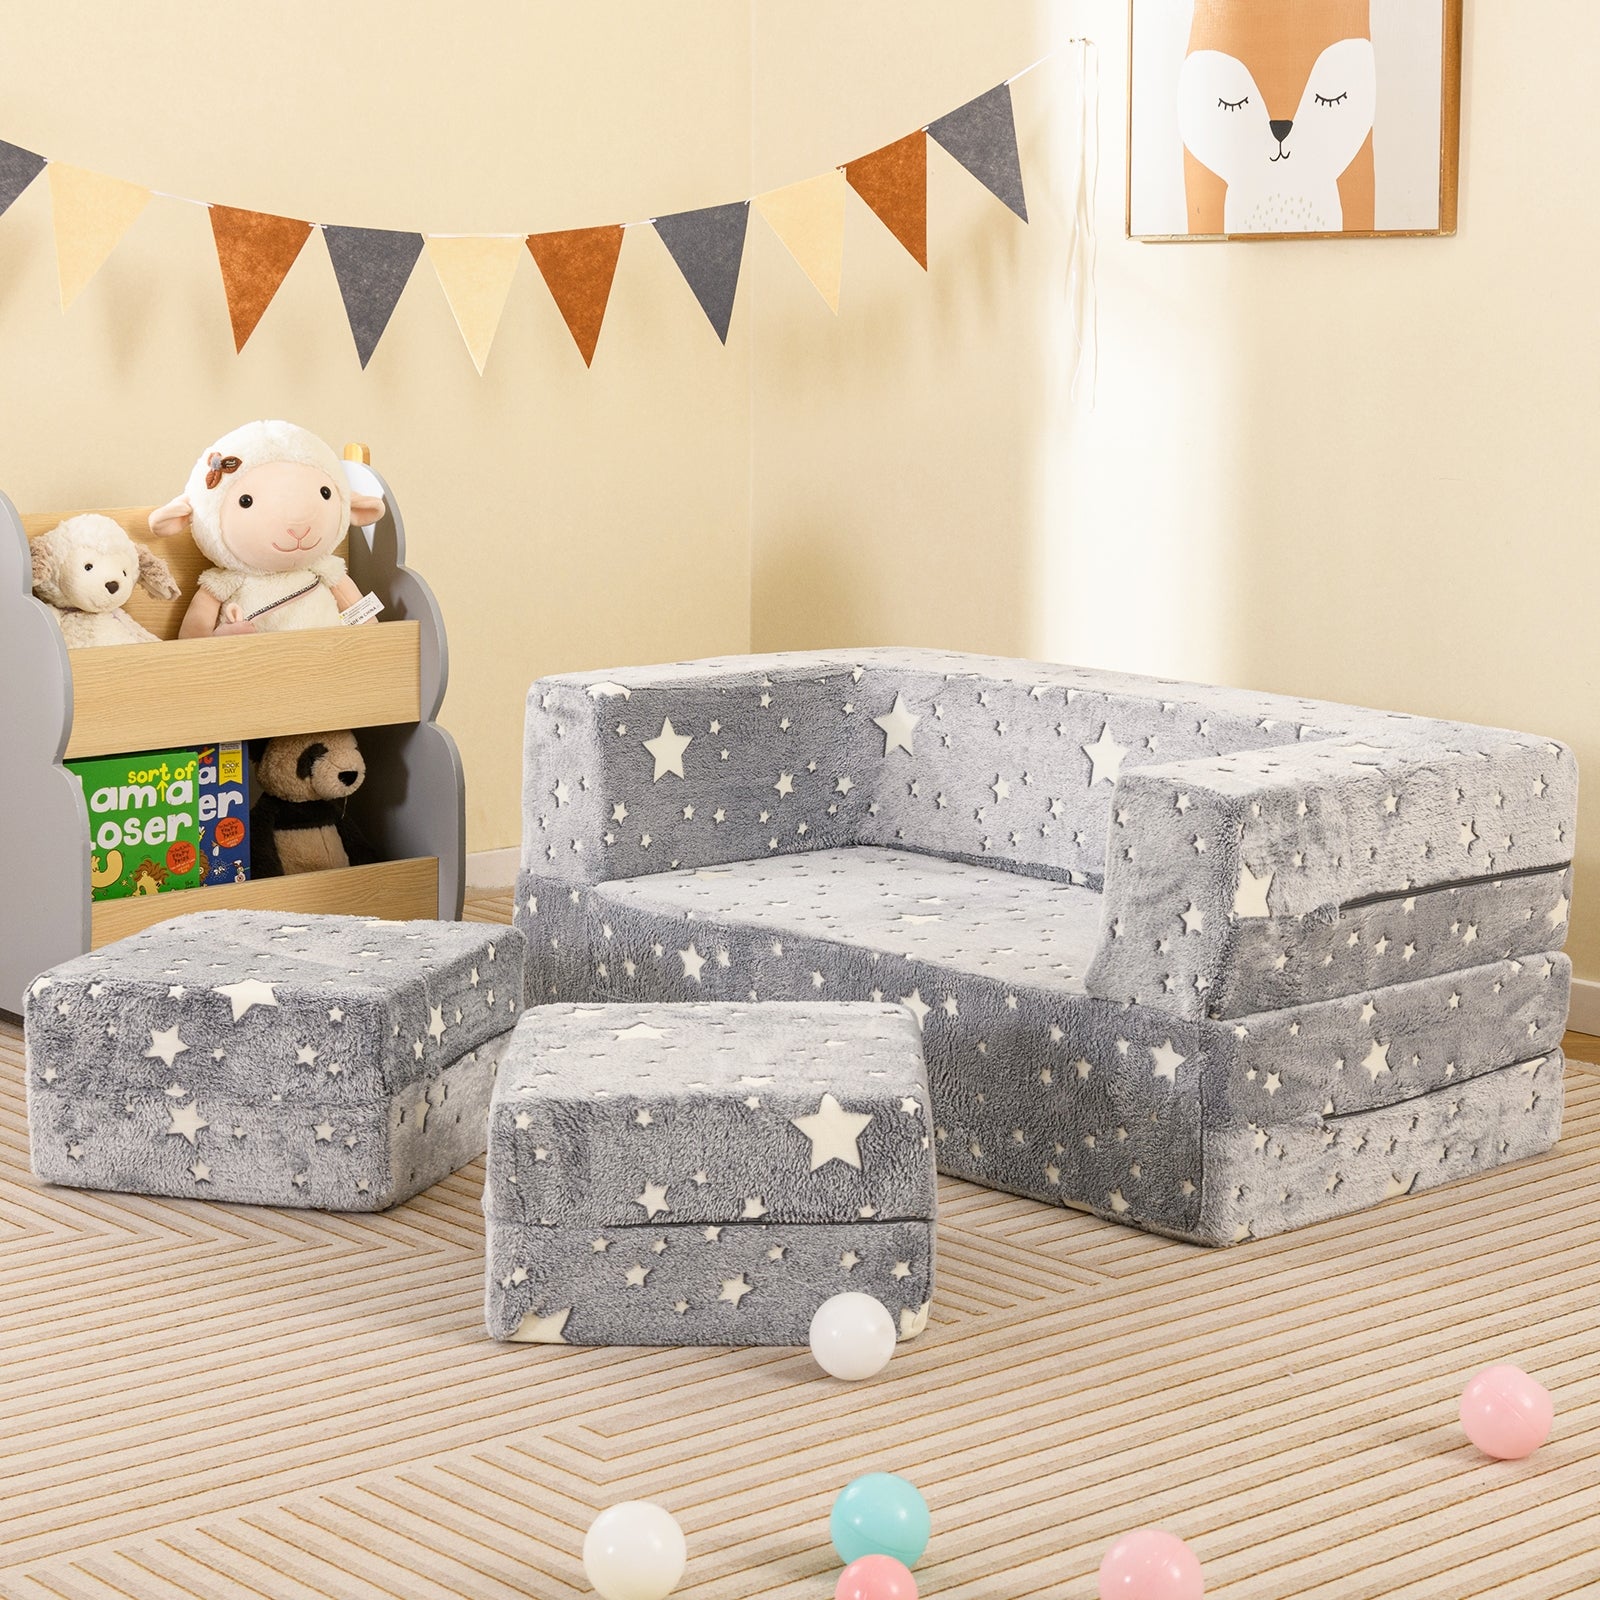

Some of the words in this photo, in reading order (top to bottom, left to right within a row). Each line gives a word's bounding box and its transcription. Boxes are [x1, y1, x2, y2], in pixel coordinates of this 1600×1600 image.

[128, 763, 170, 784] sort
[174, 761, 196, 781] of
[90, 785, 157, 813] am
[166, 780, 194, 806] a
